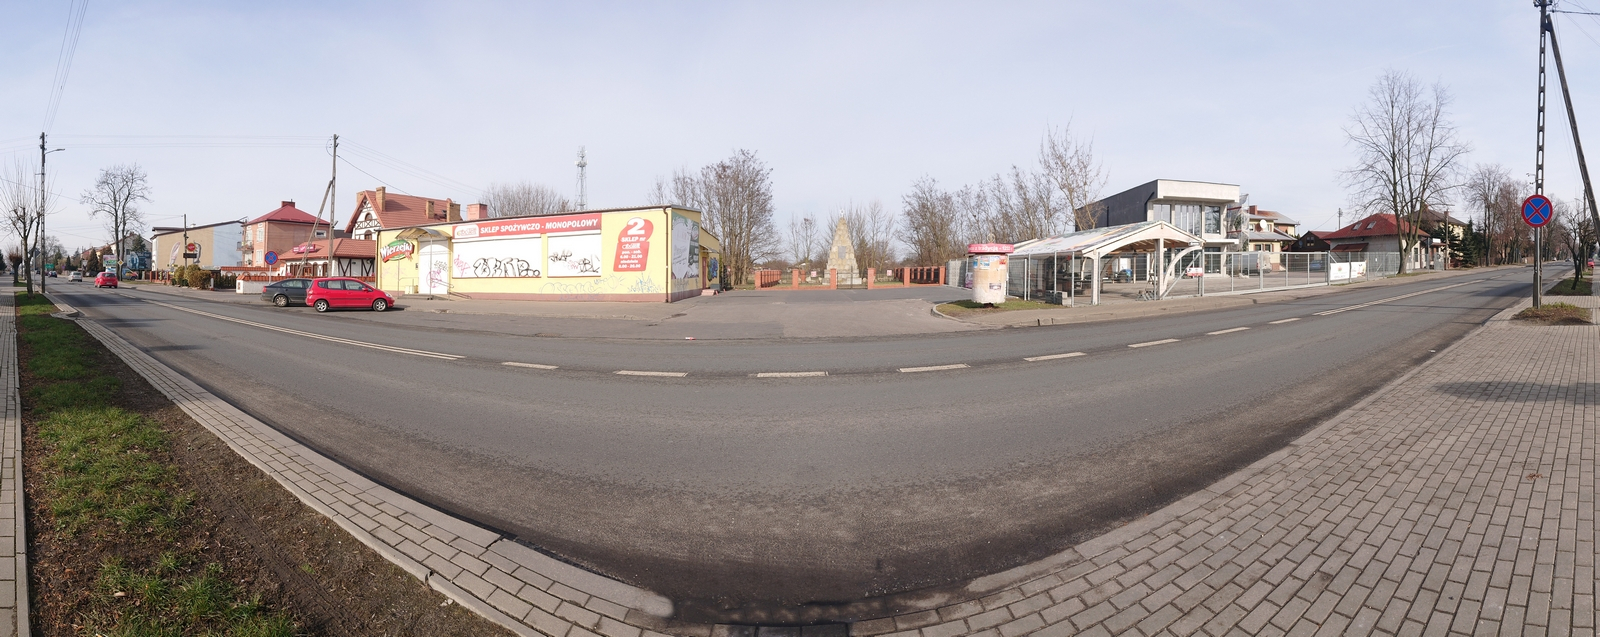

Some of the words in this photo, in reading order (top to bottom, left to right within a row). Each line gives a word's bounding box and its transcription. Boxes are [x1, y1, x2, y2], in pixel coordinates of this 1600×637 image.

[480, 226, 500, 234] SKLEP
[500, 222, 541, 232] SPOŻYWCZO
[545, 218, 599, 230] MONOPOLOWY
[627, 218, 645, 235] 2
[380, 242, 413, 259] Wierzejki
